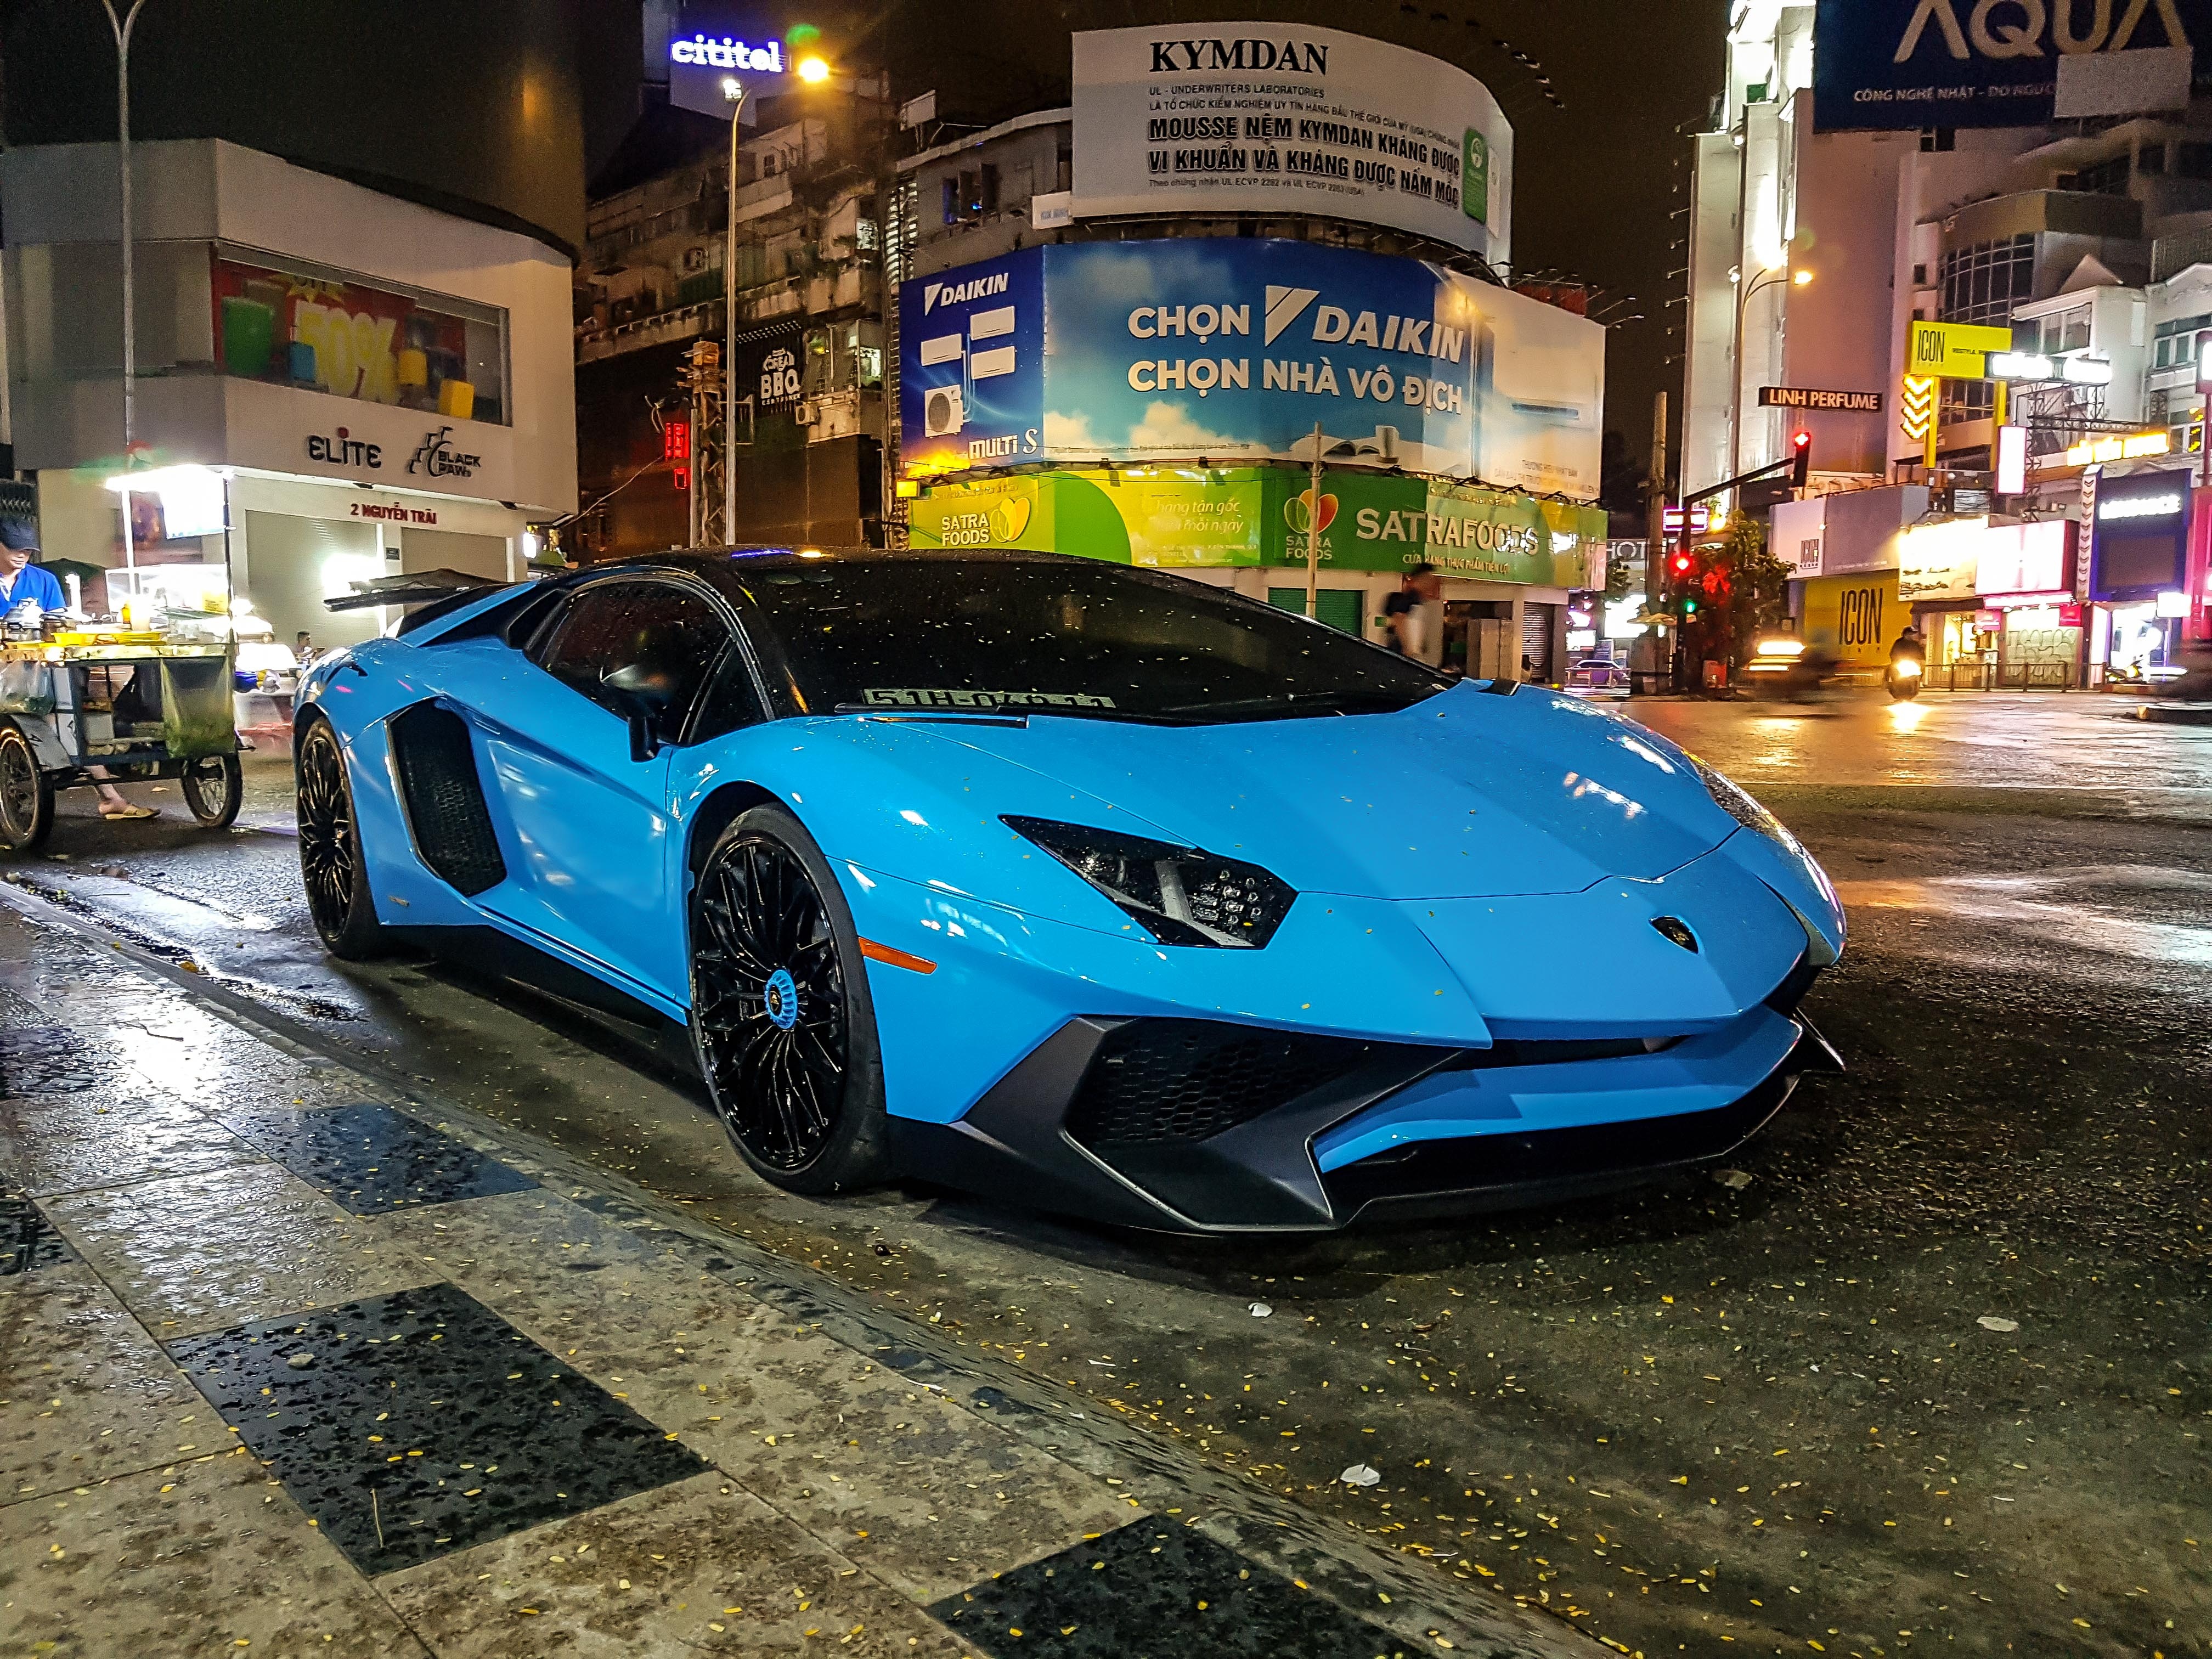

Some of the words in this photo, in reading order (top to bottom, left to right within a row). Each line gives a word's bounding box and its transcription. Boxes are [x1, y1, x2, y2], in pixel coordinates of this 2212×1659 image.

[1893, 0, 2190, 63] AQUA
[672, 34, 782, 72] cititel
[1149, 40, 1329, 76] KYMDAN
[1149, 86, 1161, 95] UL
[1171, 84, 1250, 95] UNDERWRITERS
[1253, 84, 1325, 99] LABORATORIES
[1149, 116, 1237, 139] MOUSSE
[1300, 118, 1373, 150] KYMDAN
[1378, 134, 1427, 164] KHÁNG
[1149, 150, 1167, 171] VI
[1286, 149, 1348, 178] KHÁNG
[940, 273, 1009, 306] DAIKIN
[1127, 304, 1250, 344] CHỌN
[1312, 305, 1464, 363] DAIKIN
[1917, 330, 1946, 363] ICON
[760, 369, 801, 399] BBQ
[1127, 358, 1249, 398] CHỌN
[1263, 356, 1340, 397] NHÀ
[1347, 364, 1395, 403] VÔ
[1402, 375, 1462, 416] ĐỊCH
[1769, 388, 1807, 406] LINH
[1810, 391, 1878, 410] PERFUME
[1022, 428, 1039, 454] S
[438, 450, 481, 467] BLACK
[350, 503, 359, 516] 2
[941, 512, 990, 531] SATRA
[941, 528, 990, 547] FOODS
[1356, 508, 1539, 556] SATRAFOODS
[1838, 588, 1883, 646] ICON
